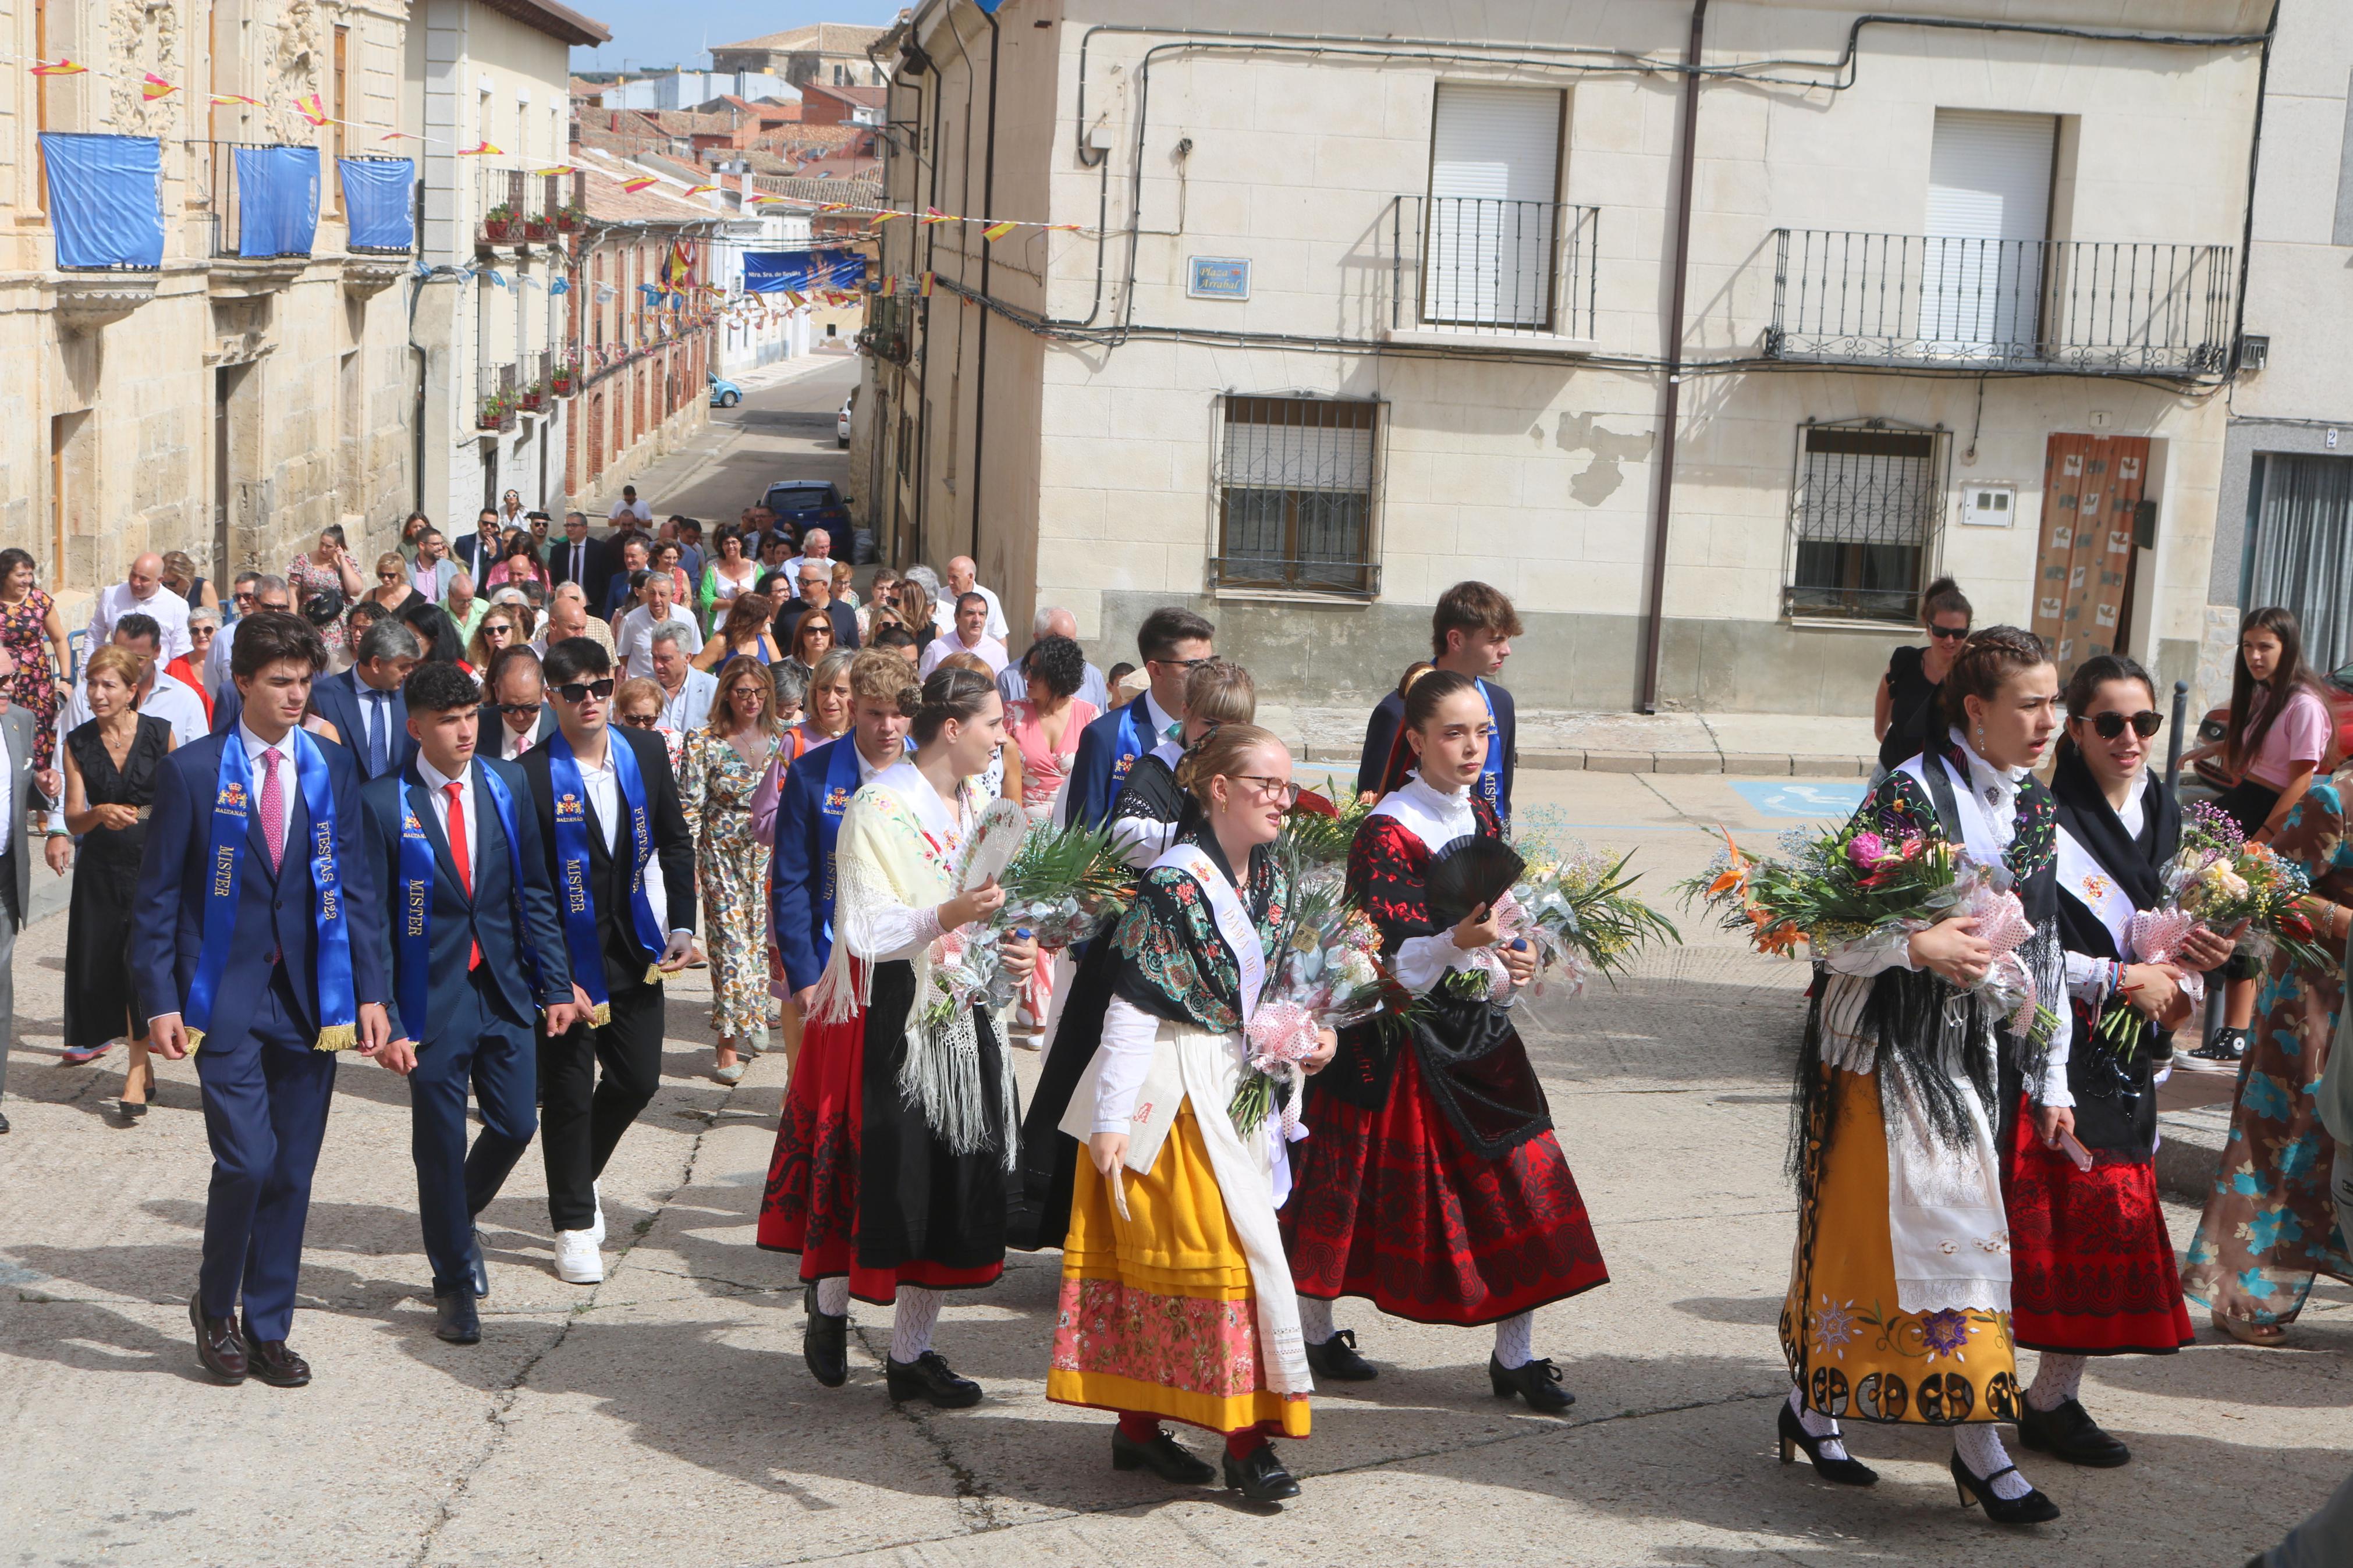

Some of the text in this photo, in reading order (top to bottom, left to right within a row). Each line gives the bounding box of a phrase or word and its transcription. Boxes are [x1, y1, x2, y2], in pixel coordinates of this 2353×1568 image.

[1198, 279, 1241, 289] Arrabal
[1199, 266, 1228, 277] Plaza
[2097, 414, 2102, 424] 1
[2329, 432, 2336, 445] 2
[215, 807, 247, 817] BALTANÁS
[1485, 771, 1496, 810] MIST
[634, 806, 648, 862] FIESTAS
[214, 845, 234, 897] MISTER
[317, 820, 337, 920] FIESTAS 2023
[566, 858, 585, 913] MISTER
[823, 851, 836, 900] MISTER
[409, 879, 425, 937] MISTER
[1223, 908, 1250, 950] DAMA
[1245, 956, 1257, 977] DE
